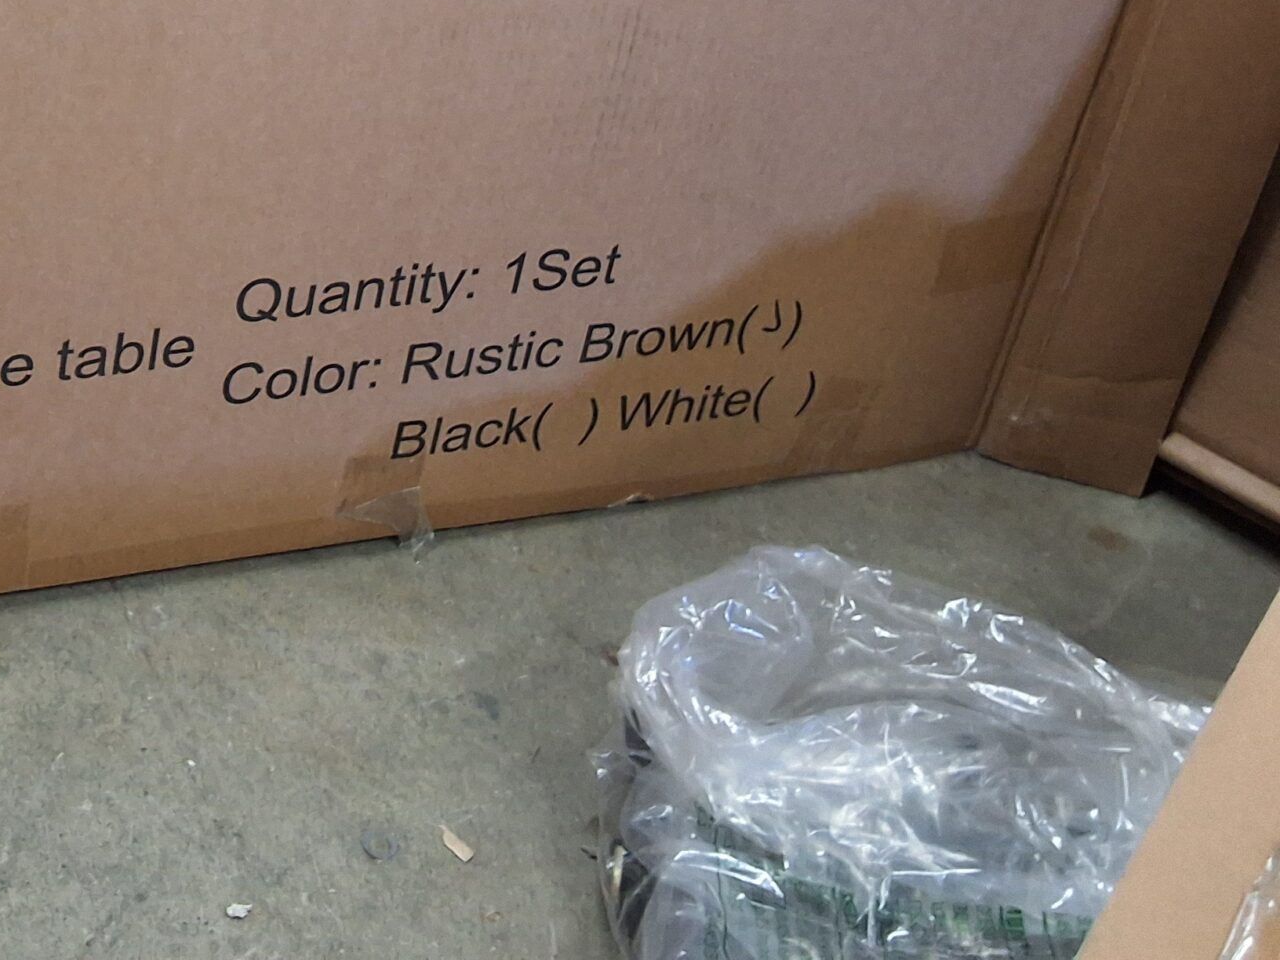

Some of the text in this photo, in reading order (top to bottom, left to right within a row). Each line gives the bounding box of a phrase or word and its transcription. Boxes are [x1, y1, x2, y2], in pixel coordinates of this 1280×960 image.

[236, 244, 622, 323] Quantity: 1Set
[56, 327, 195, 381] table
[223, 356, 382, 405] Color:
[401, 331, 564, 385] Rustic
